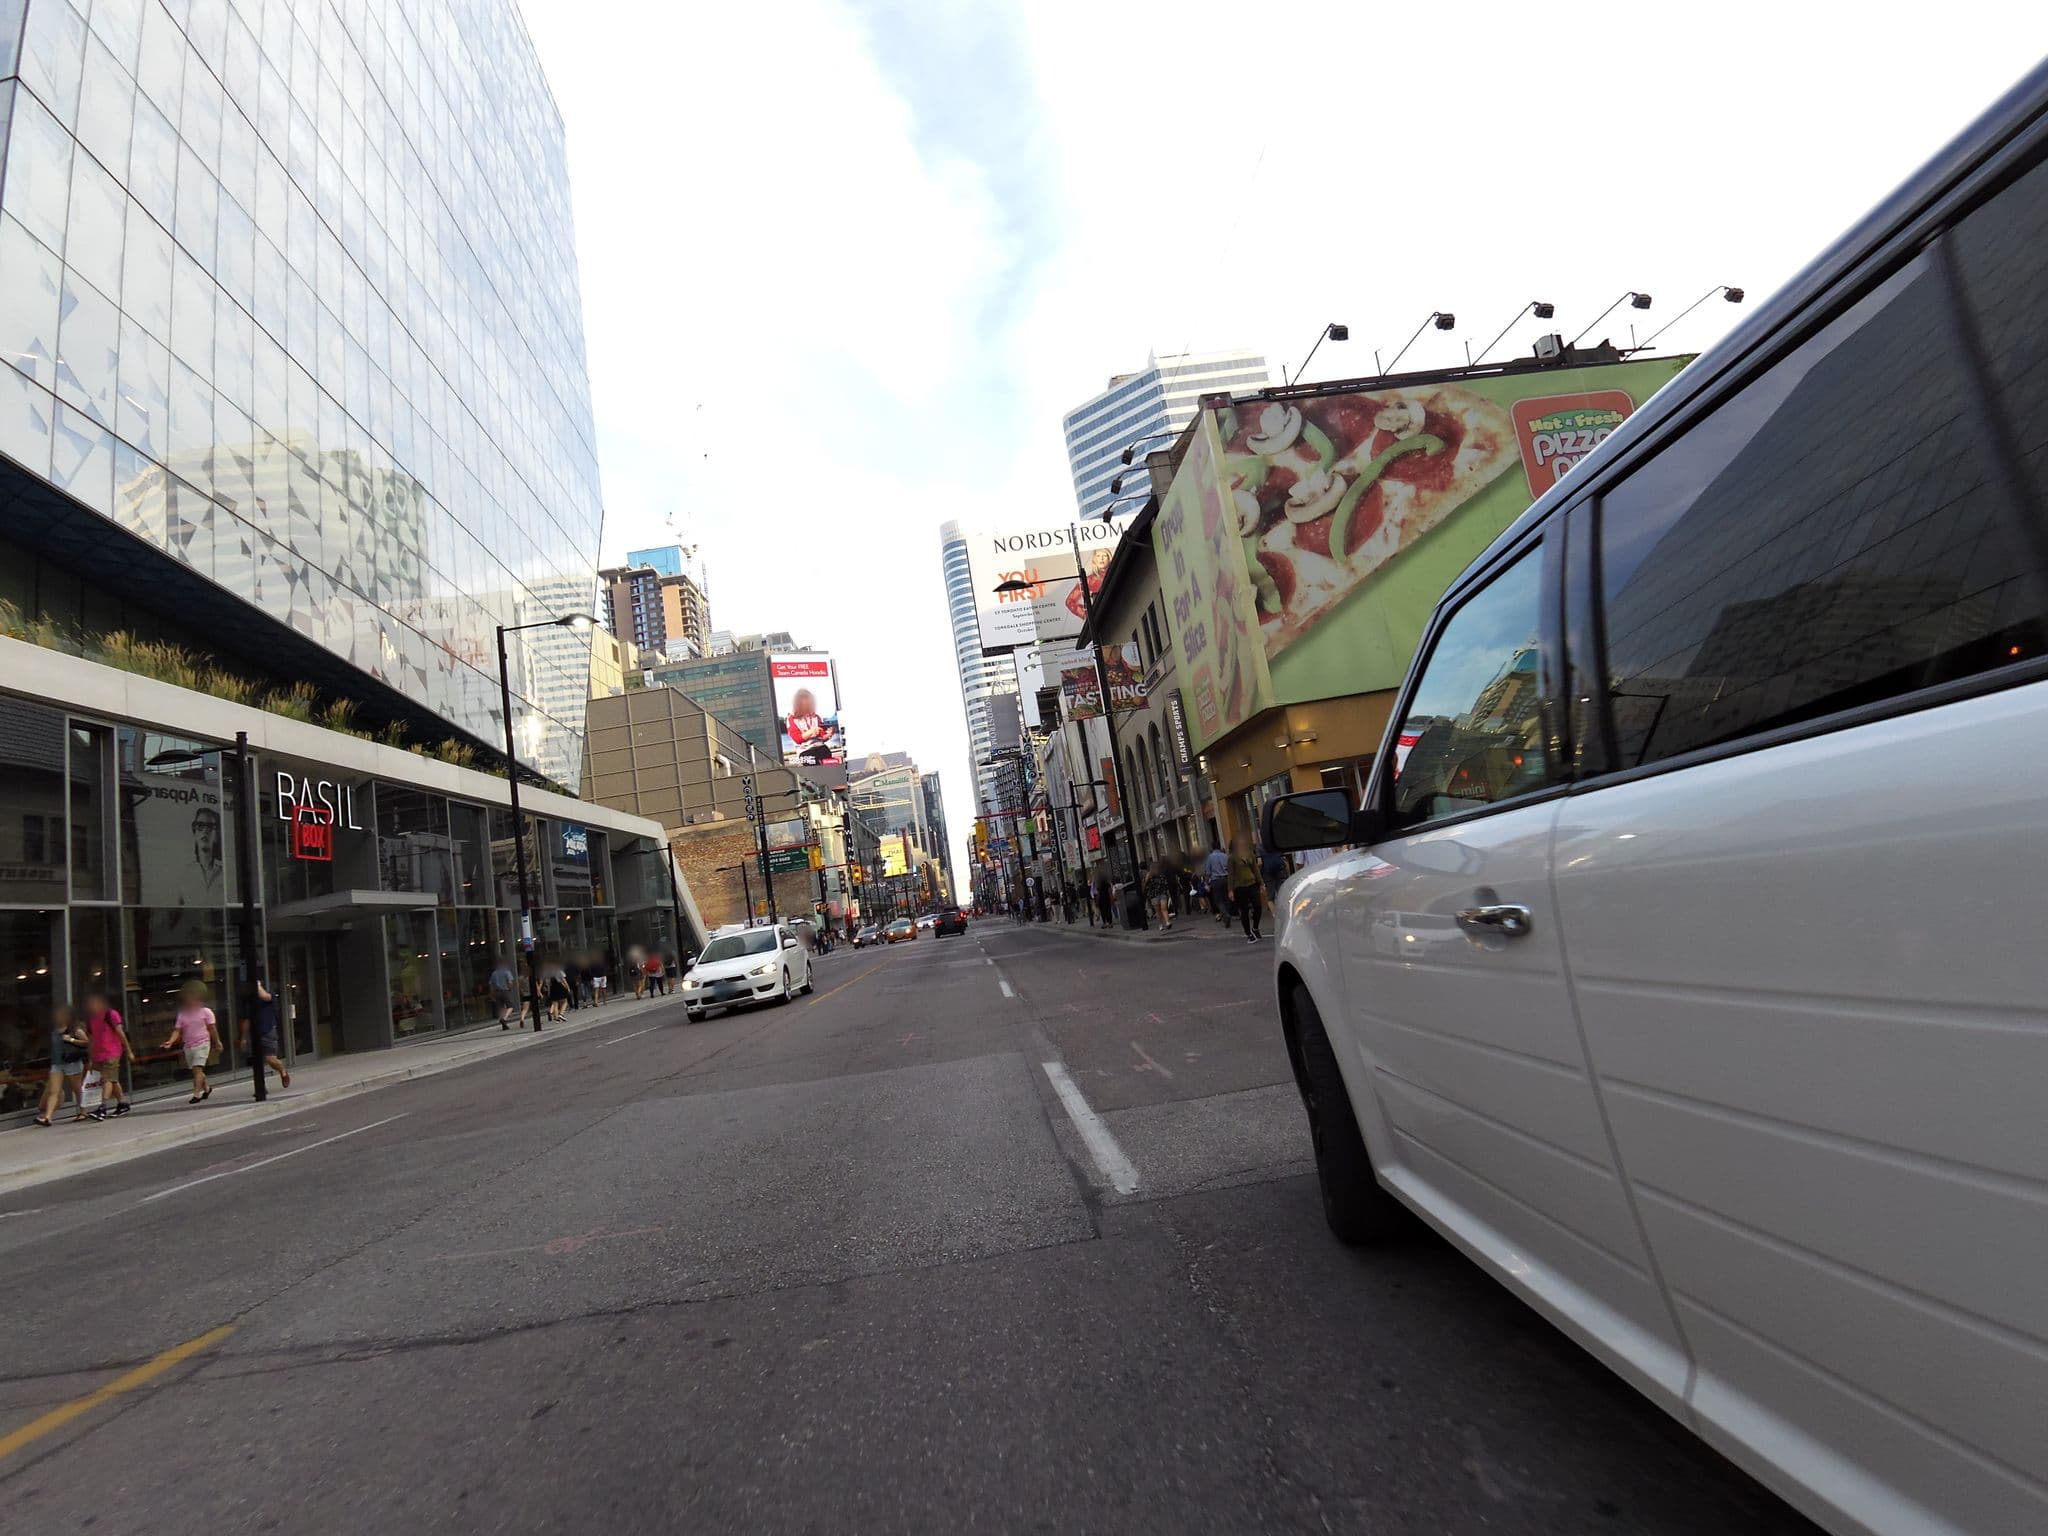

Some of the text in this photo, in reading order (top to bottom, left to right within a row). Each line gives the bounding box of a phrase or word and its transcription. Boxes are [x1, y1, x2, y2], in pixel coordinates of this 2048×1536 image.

[1529, 417, 1563, 432] Hot
[1574, 411, 1623, 427] Fresh
[994, 522, 1124, 554] NORDSTROM
[998, 568, 1039, 584] YOU
[1190, 568, 1200, 607] A
[998, 584, 1046, 603] FIRST
[1170, 700, 1189, 763] CHAMPS SPORTS
[277, 771, 362, 830] BASIL
[302, 823, 325, 848] BOX
